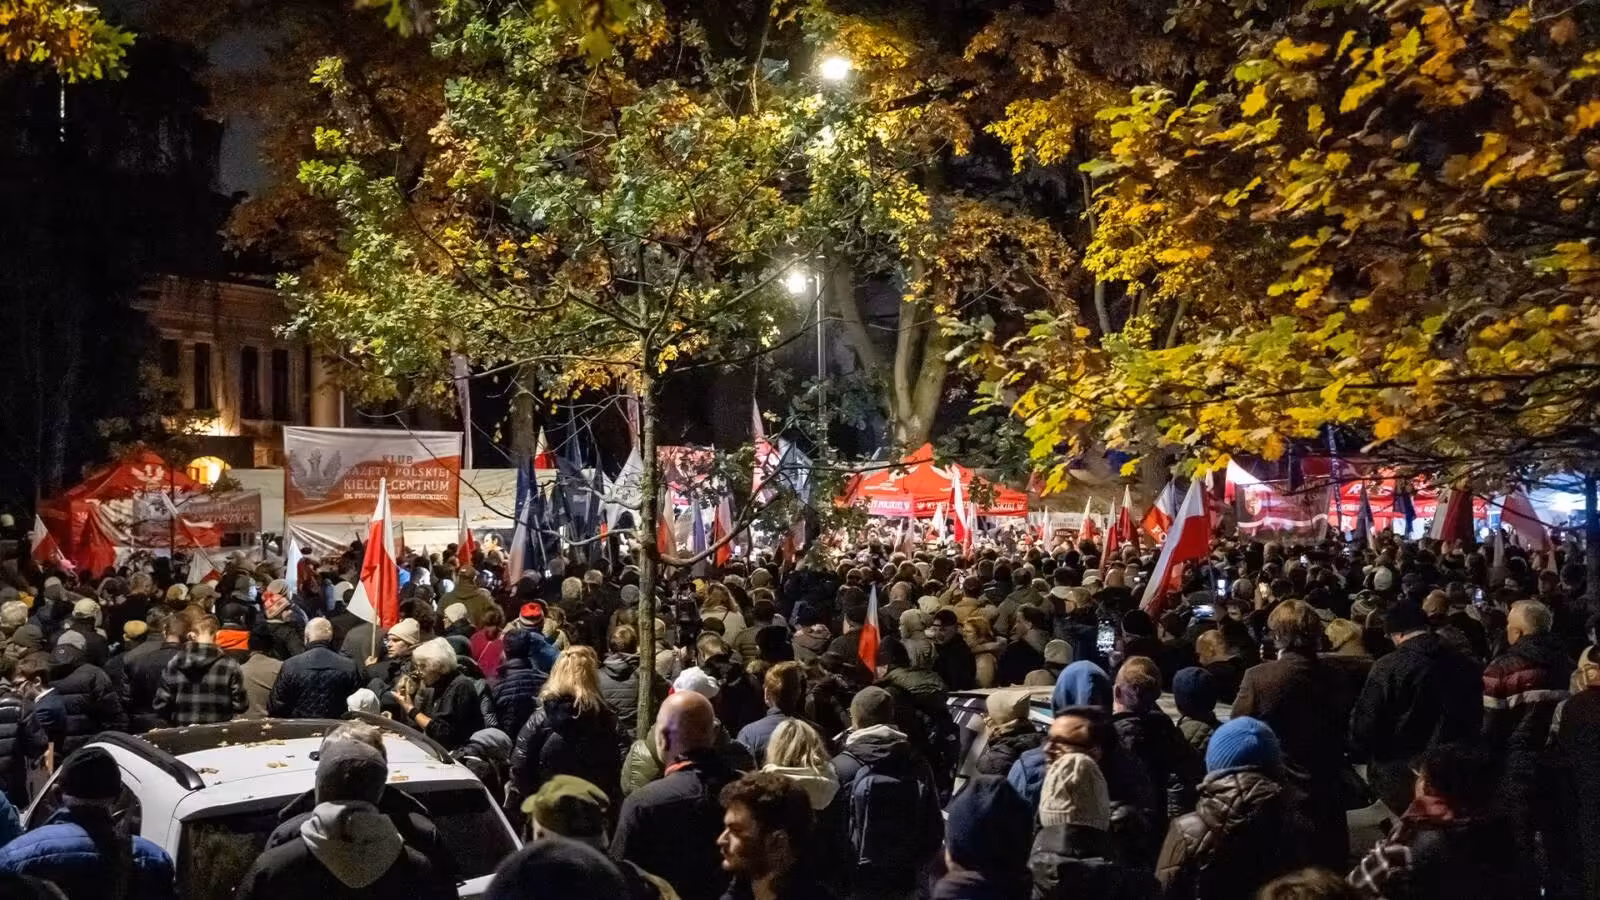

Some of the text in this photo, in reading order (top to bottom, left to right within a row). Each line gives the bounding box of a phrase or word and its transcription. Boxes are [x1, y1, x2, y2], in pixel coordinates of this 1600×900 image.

[382, 455, 413, 464] KLUB
[395, 467, 450, 479] POLSKIEJ
[344, 479, 449, 491] KIELC-CENTRUM
